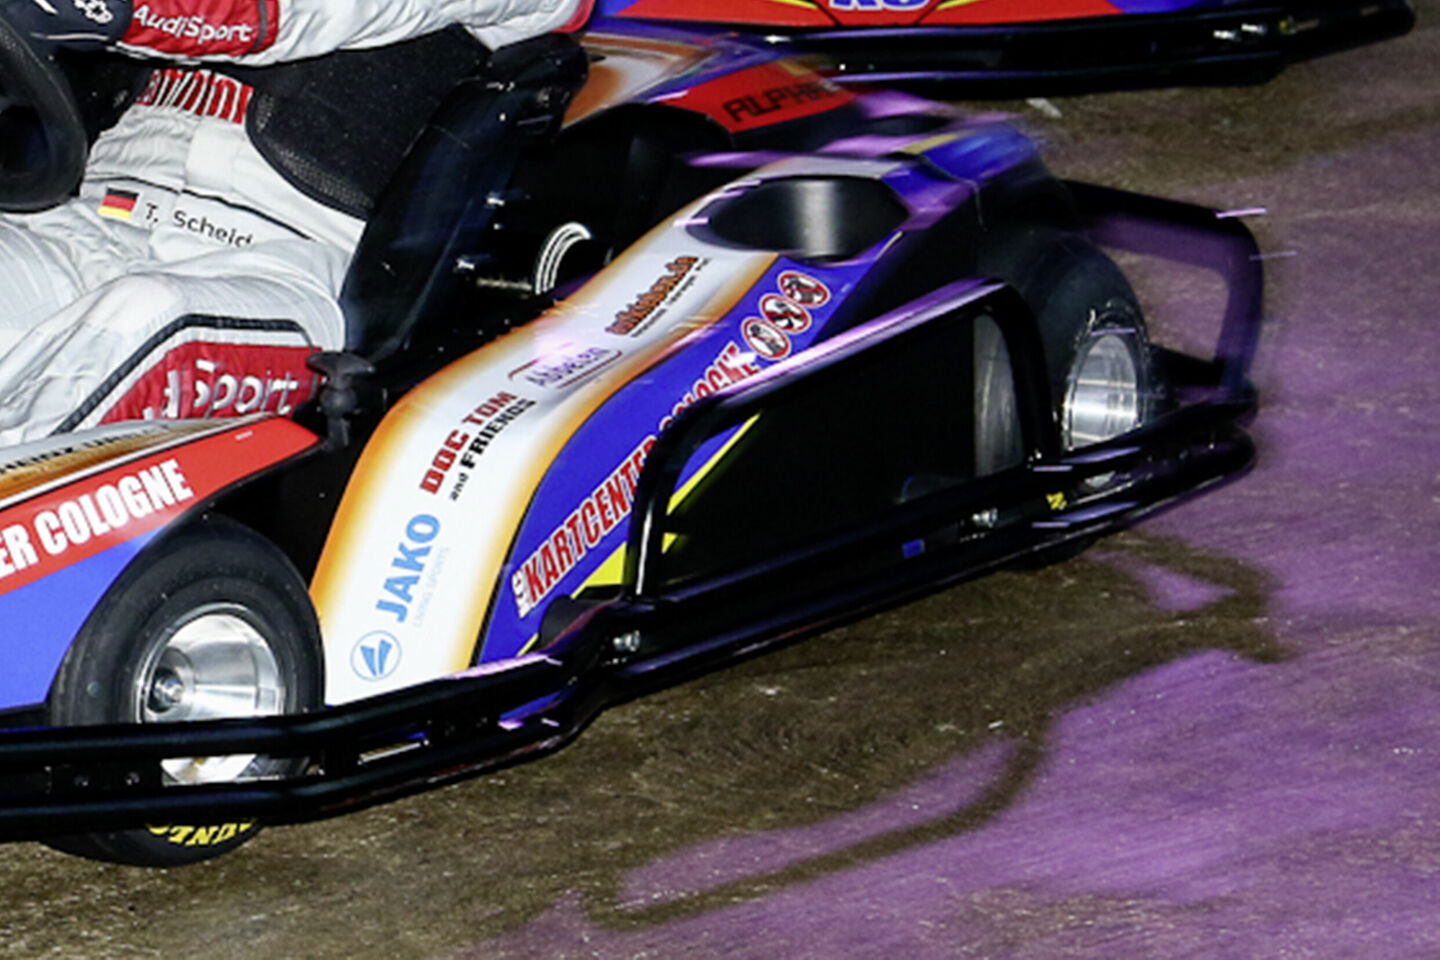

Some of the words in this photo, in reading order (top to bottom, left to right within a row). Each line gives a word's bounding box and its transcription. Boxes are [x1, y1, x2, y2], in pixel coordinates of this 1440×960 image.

[419, 429, 469, 494] DOC
[462, 391, 517, 426] TOM
[460, 398, 536, 469] FRIENDS
[33, 458, 193, 556] COLOGNE
[523, 434, 658, 604] KARTCENTE
[376, 513, 441, 622] JAKO
